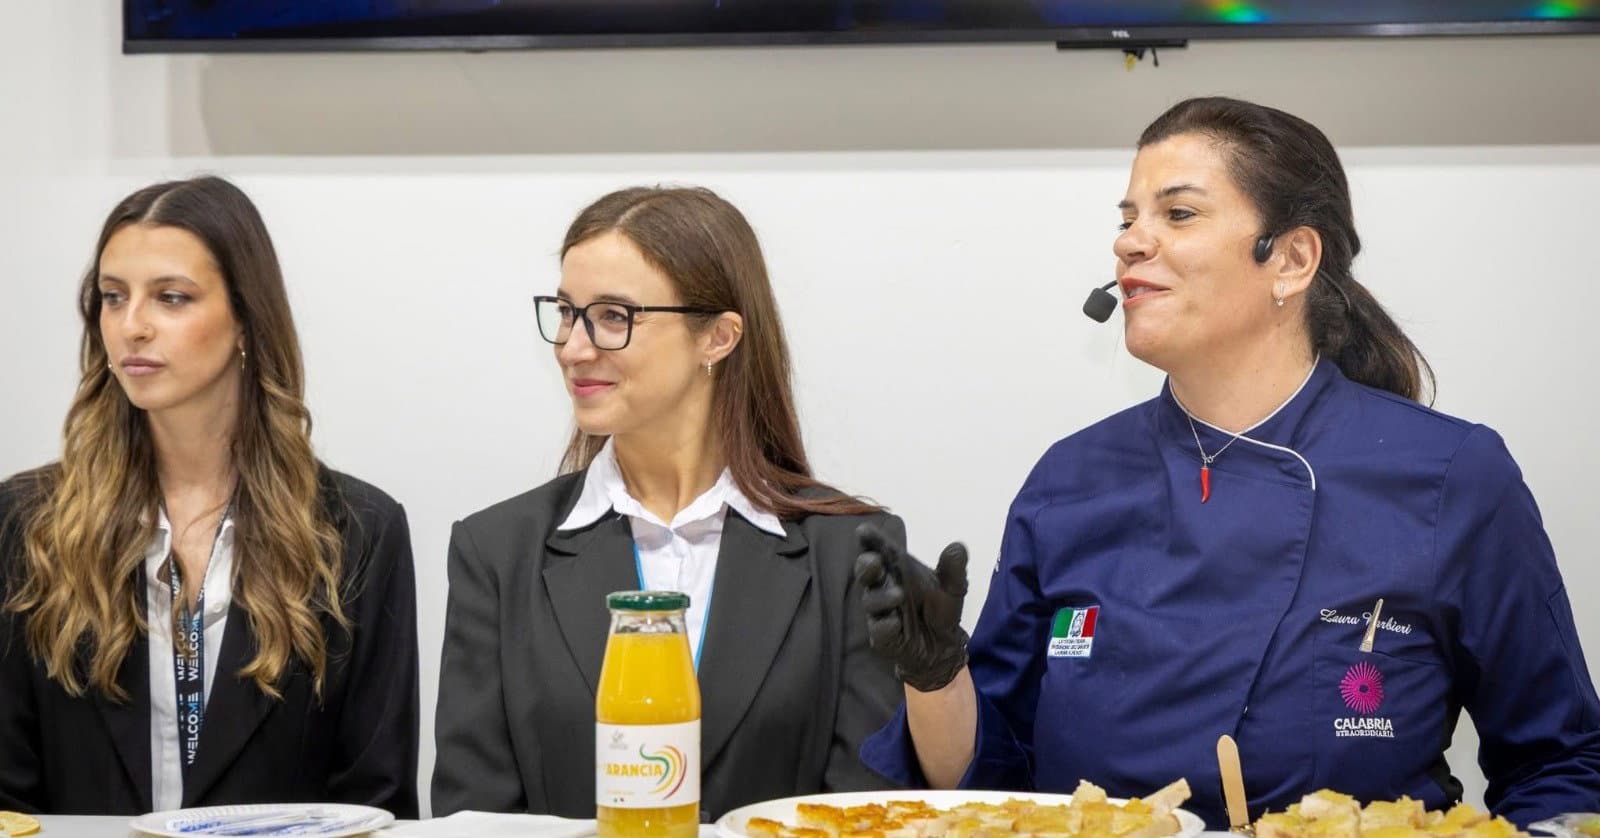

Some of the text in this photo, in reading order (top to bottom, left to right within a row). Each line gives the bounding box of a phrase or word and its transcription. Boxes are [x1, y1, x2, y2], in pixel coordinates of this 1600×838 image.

[1320, 608, 1360, 625] Laura
[1334, 717, 1394, 731] CALABRIA
[606, 763, 663, 777] ARANCIA
